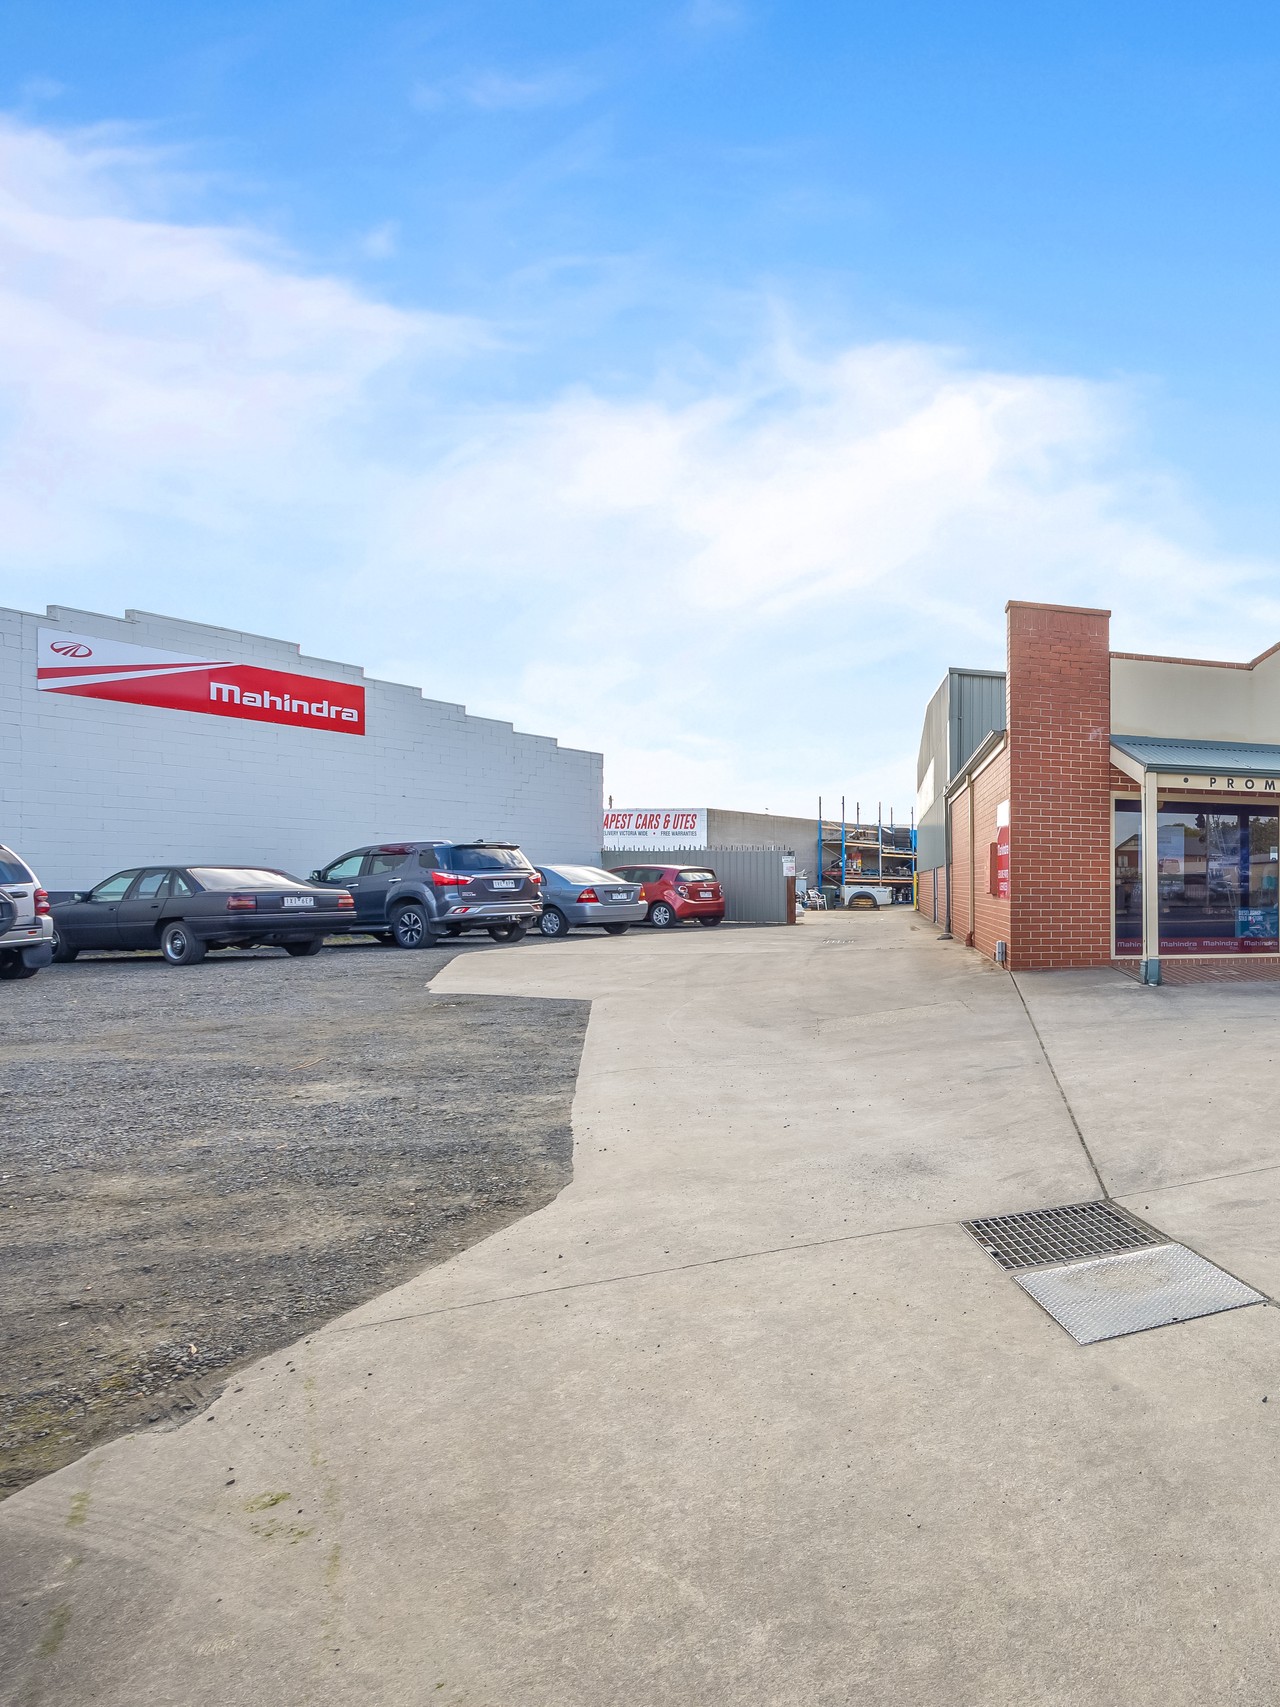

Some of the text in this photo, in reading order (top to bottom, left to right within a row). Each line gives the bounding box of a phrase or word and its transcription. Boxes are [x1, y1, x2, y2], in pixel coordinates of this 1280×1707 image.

[209, 682, 359, 722] Mahindra
[603, 813, 697, 829] APEST CARS & UTES
